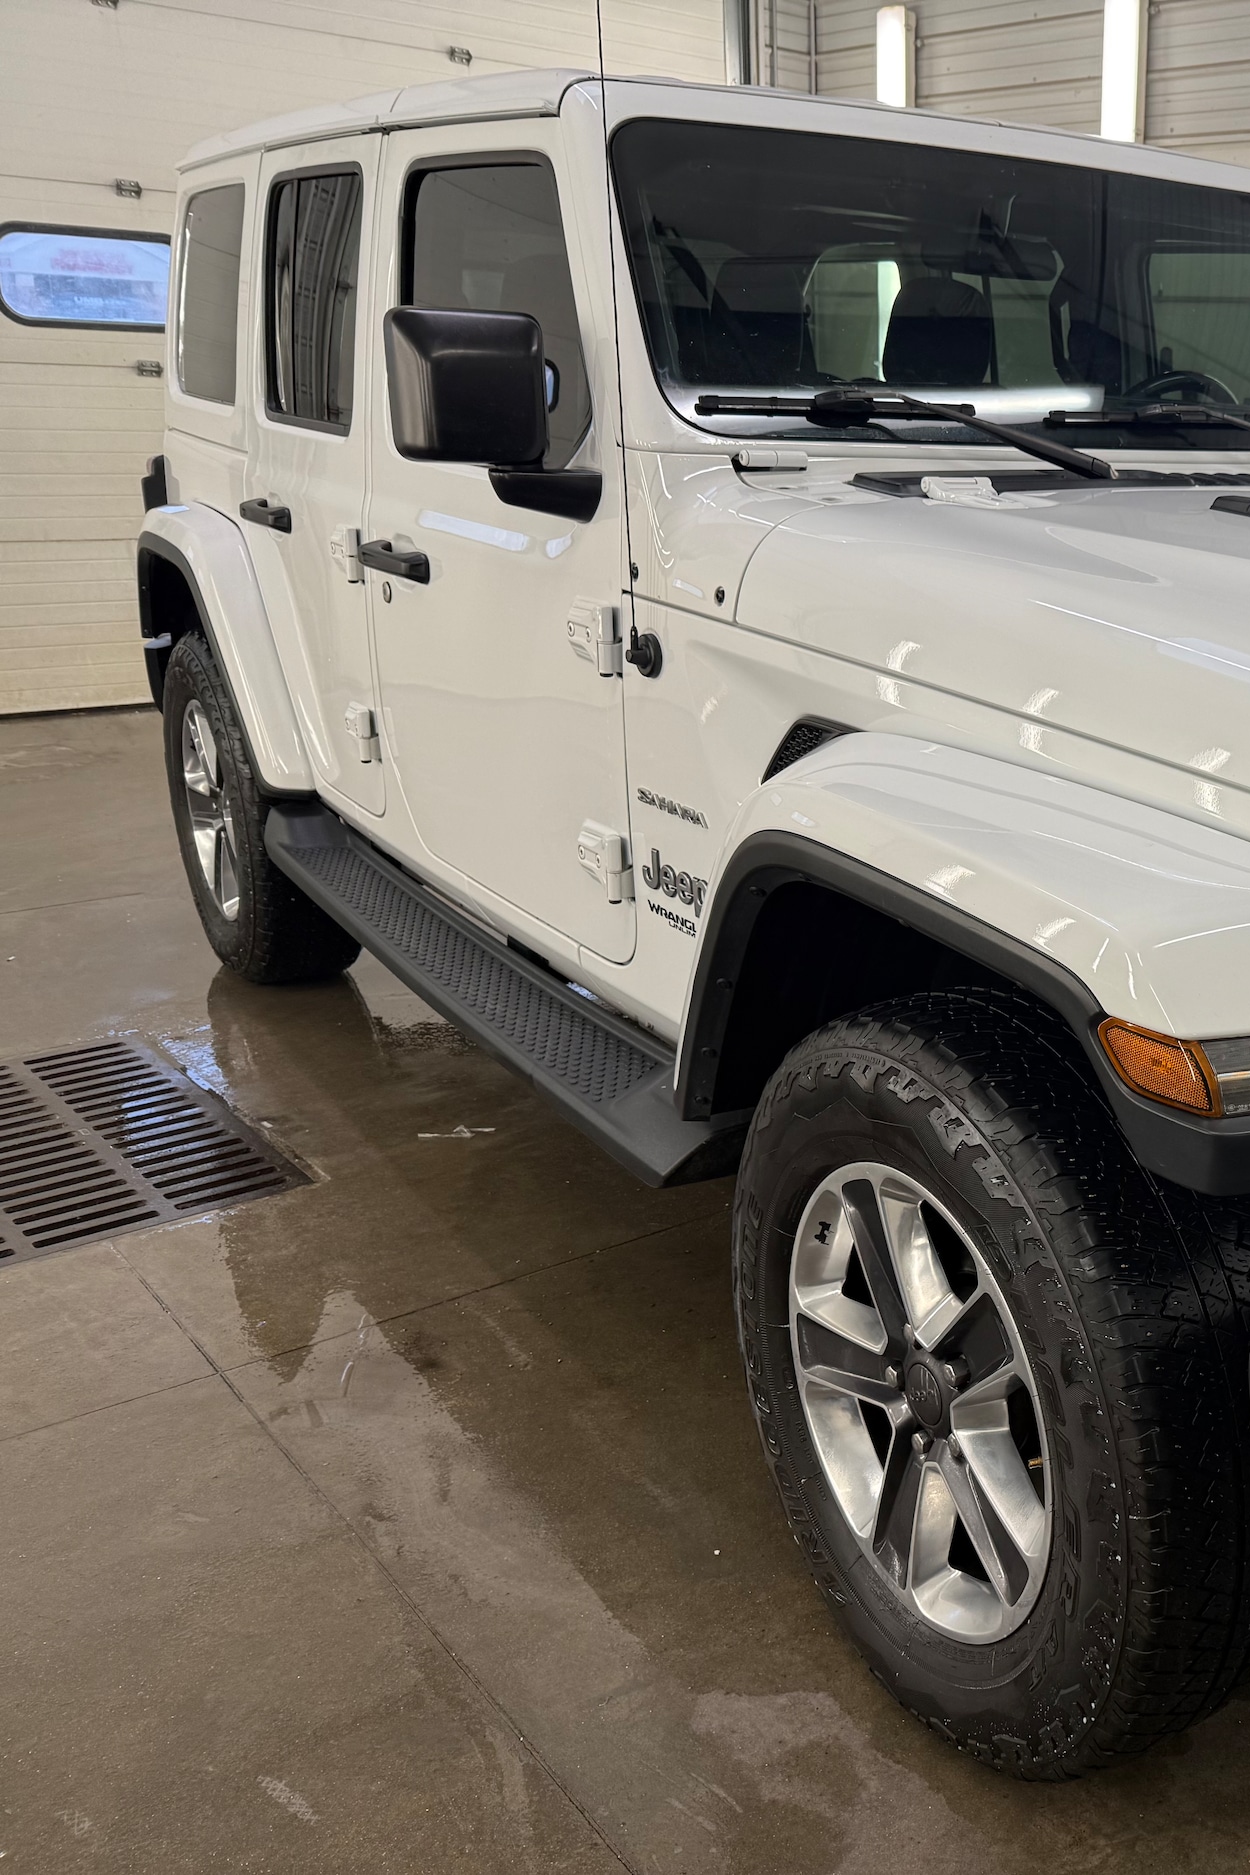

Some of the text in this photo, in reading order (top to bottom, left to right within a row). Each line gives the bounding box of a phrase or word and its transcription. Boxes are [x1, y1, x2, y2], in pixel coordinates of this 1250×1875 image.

[637, 787, 709, 829] SAHARA
[642, 848, 708, 918] Jeep
[741, 1191, 853, 1611] BRIDGESTONE
